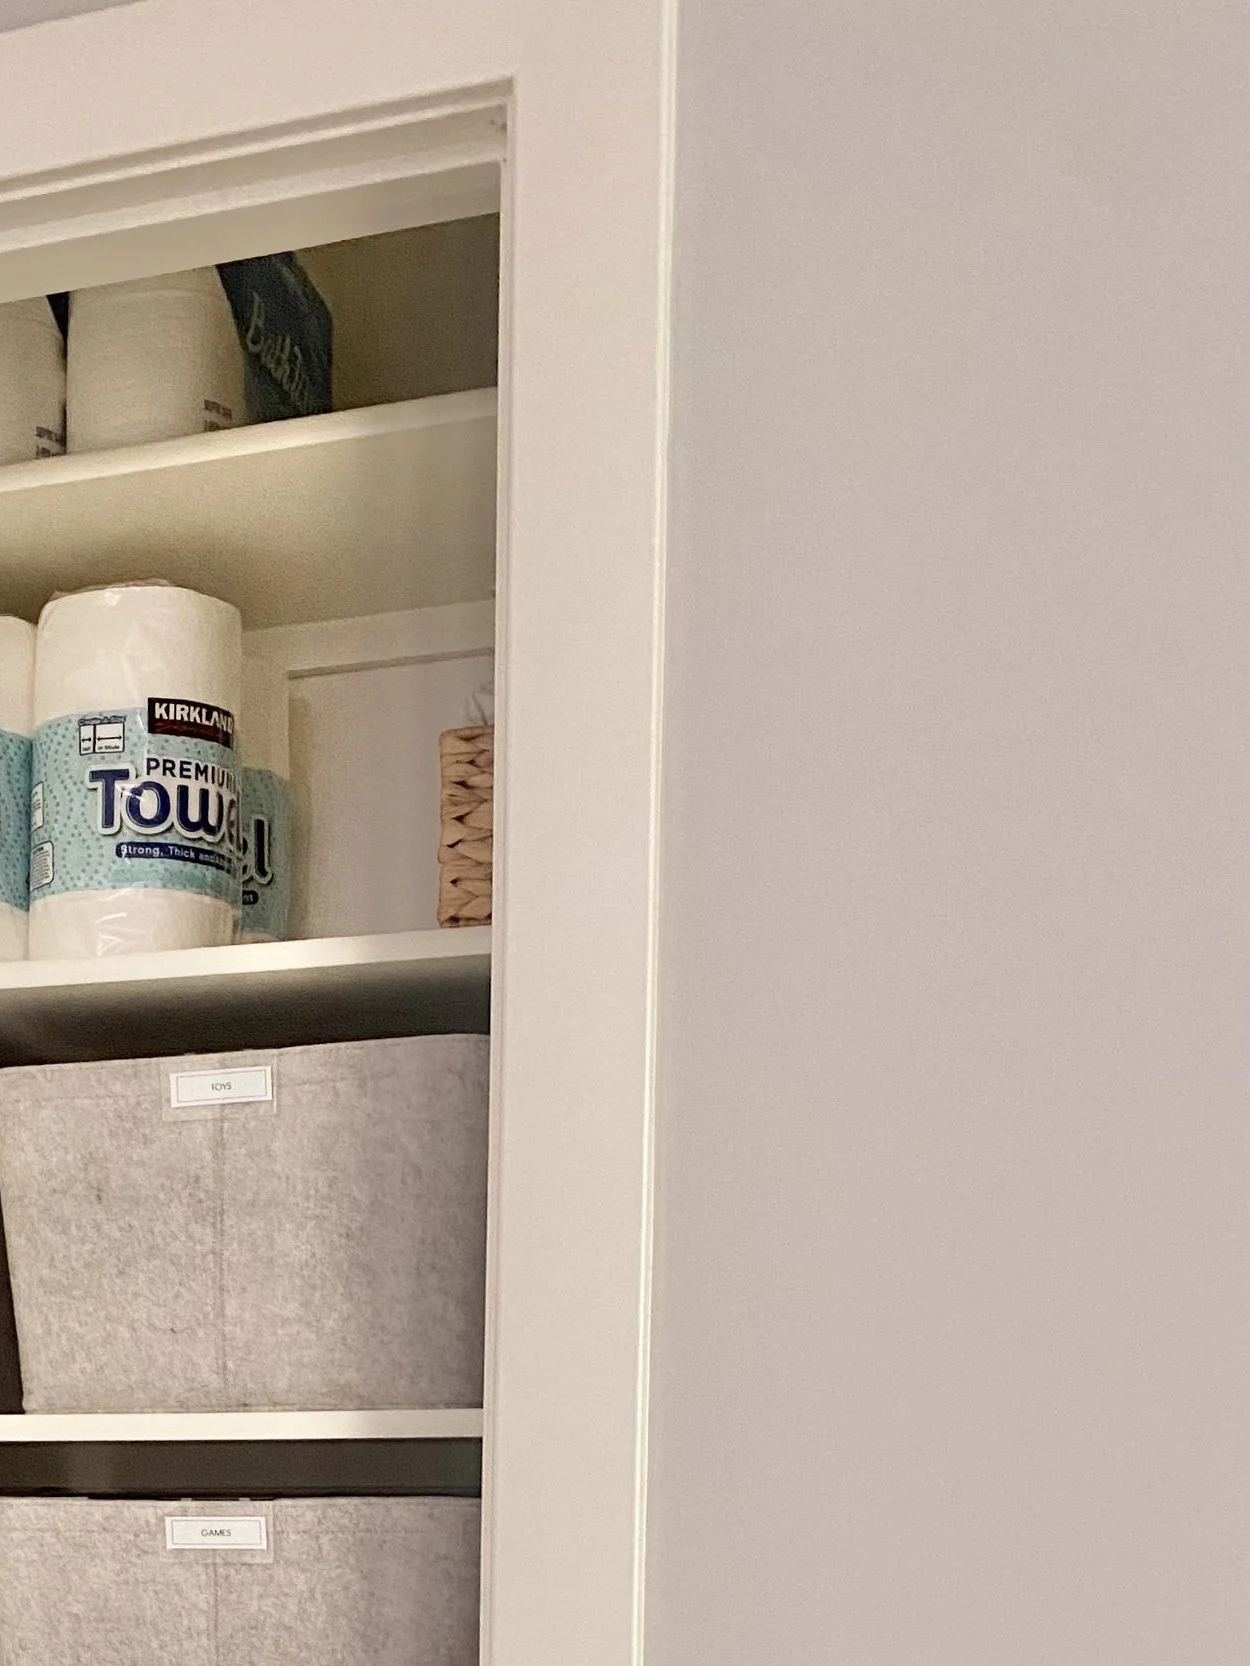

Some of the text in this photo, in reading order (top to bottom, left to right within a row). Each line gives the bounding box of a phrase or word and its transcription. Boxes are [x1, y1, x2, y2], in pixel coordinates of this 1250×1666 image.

[155, 702, 234, 734] KIRKLAND
[168, 846, 196, 859] Thick
[211, 1082, 232, 1091] TOYS
[201, 1528, 231, 1537] GAMES
